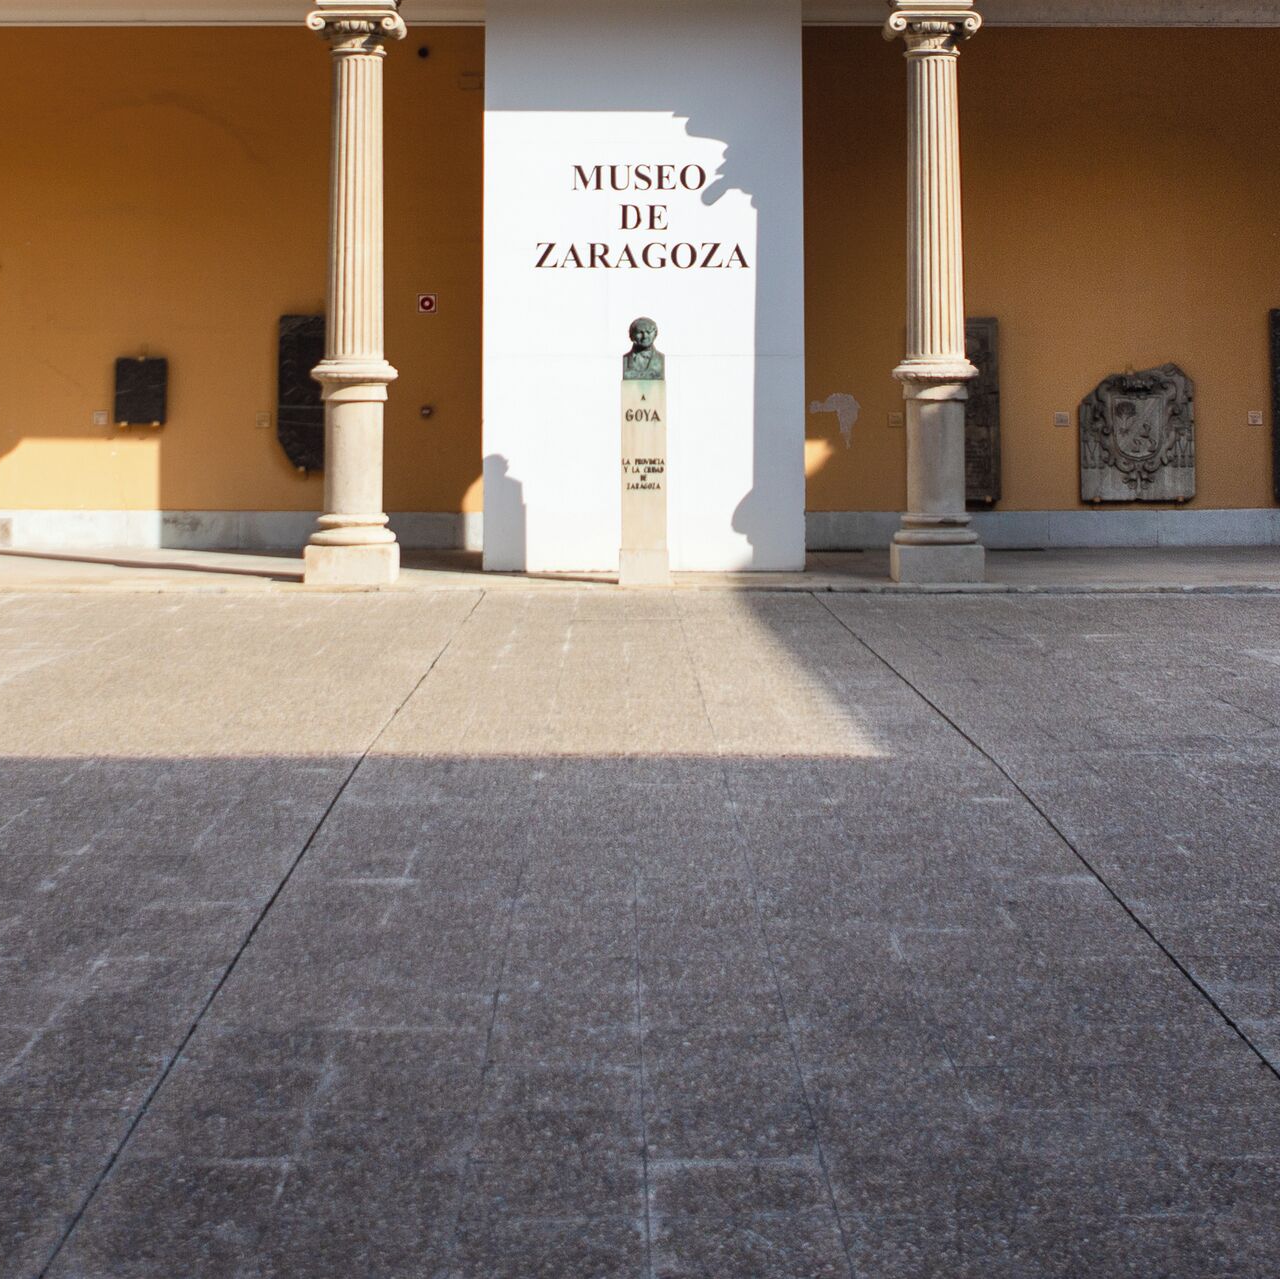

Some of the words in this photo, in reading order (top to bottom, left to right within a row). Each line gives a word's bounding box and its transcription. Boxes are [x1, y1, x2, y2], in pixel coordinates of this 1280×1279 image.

[572, 164, 706, 191] MUSEO
[619, 204, 669, 230] DE
[535, 242, 750, 269] ZARAGOZA
[625, 408, 661, 422] GOYA
[634, 458, 665, 466] PROVINCIA
[626, 482, 661, 490] ZARAGOZA
